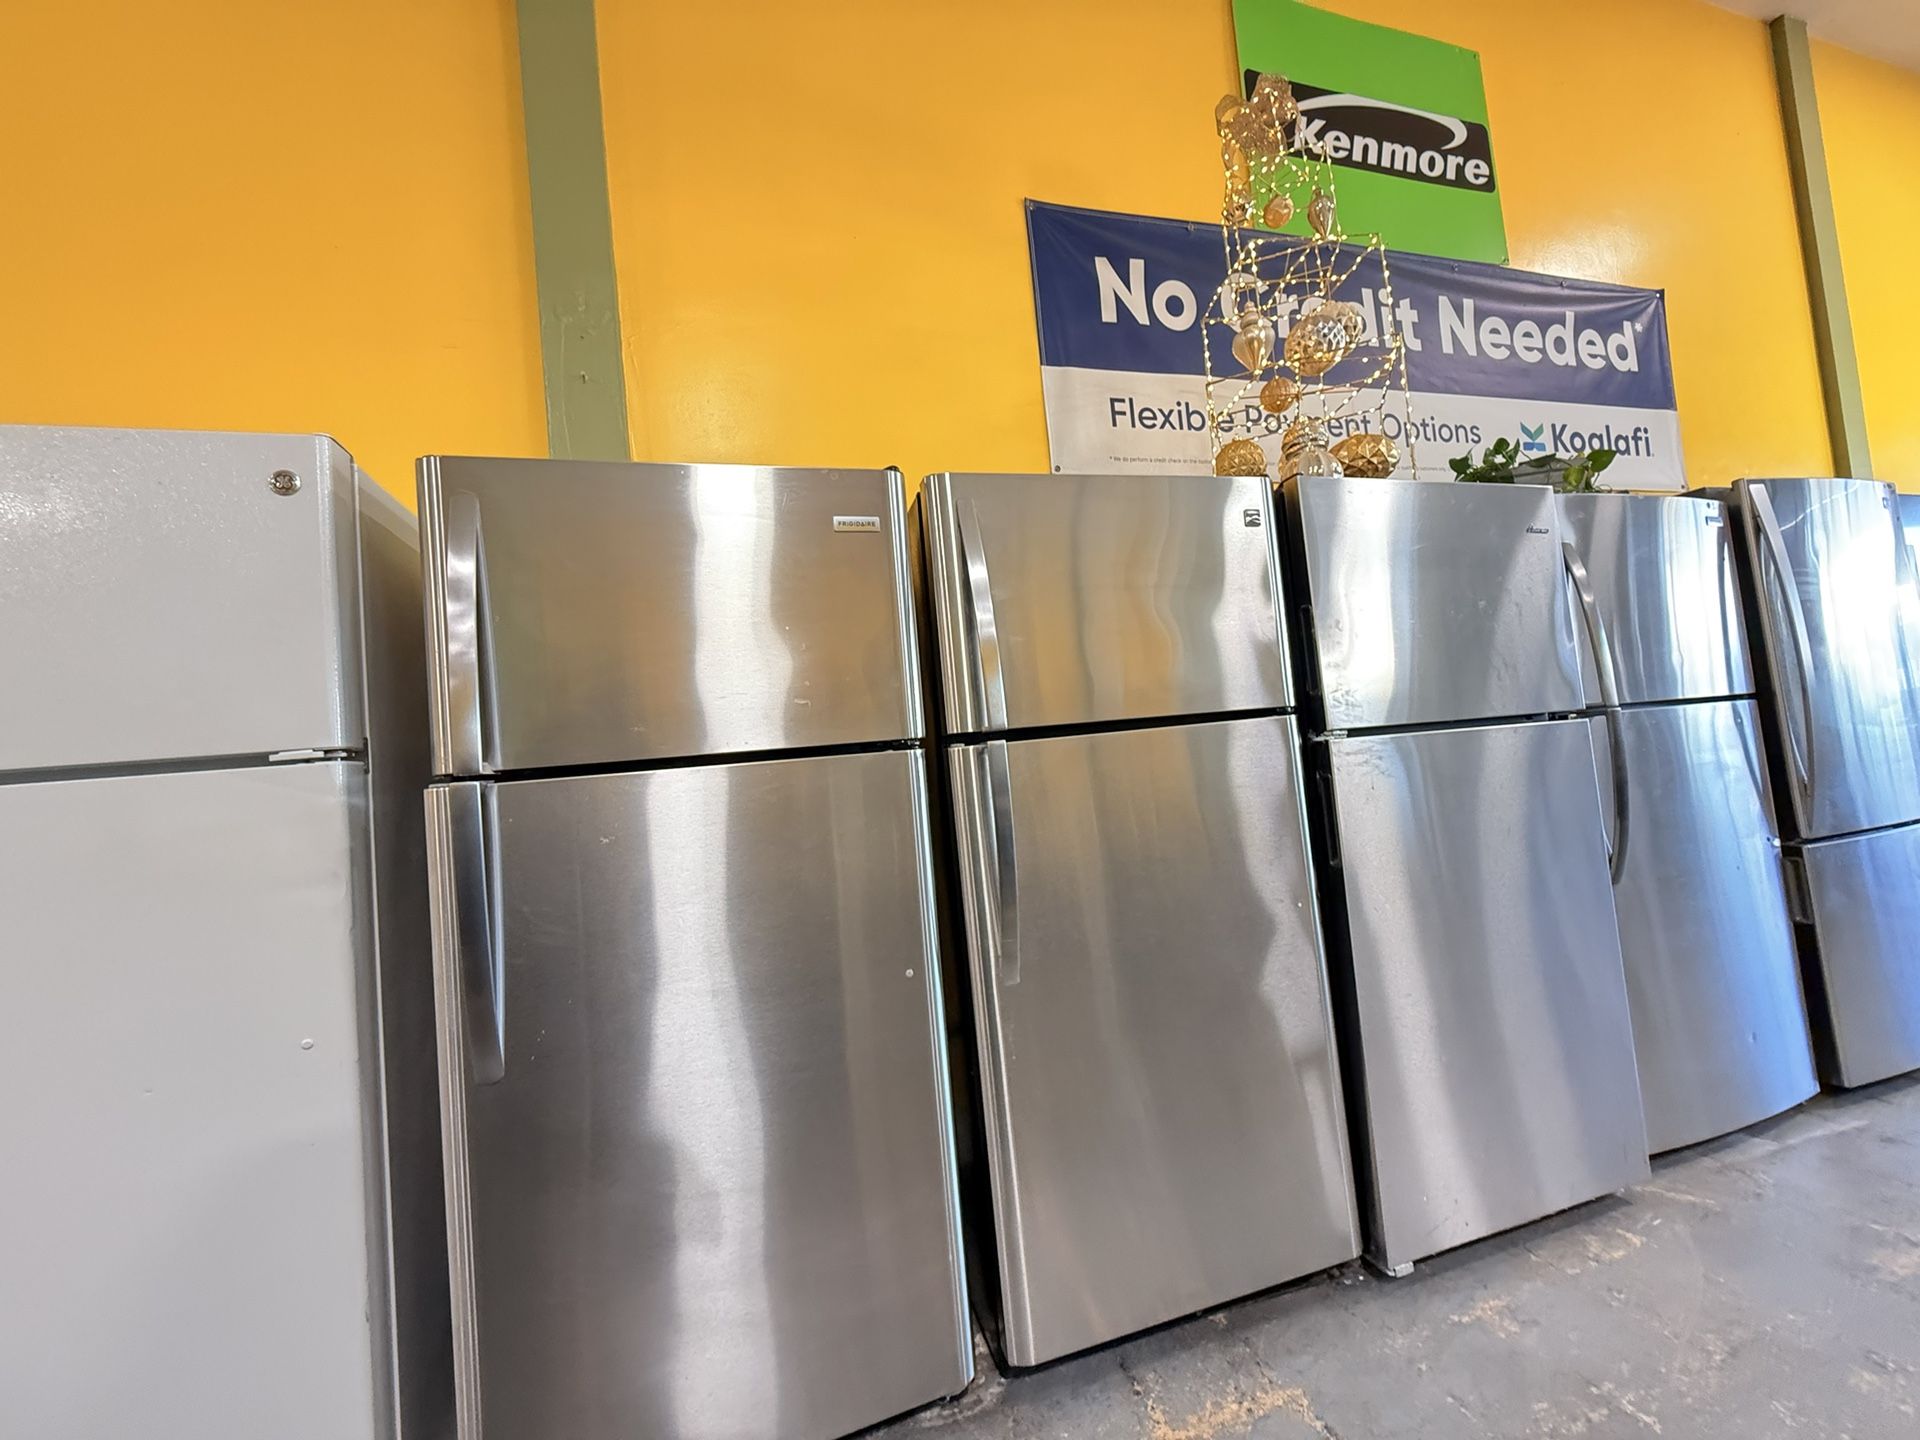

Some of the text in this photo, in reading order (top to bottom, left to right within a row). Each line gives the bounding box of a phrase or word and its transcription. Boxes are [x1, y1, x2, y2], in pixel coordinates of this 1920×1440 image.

[1294, 115, 1490, 185] Kenmore
[1094, 256, 1198, 331] No
[1109, 397, 1234, 433] Flexibe
[1382, 413, 1482, 447] Options
[1551, 423, 1651, 457] Koalafi
[837, 520, 877, 528] FRIGIDAIRE
